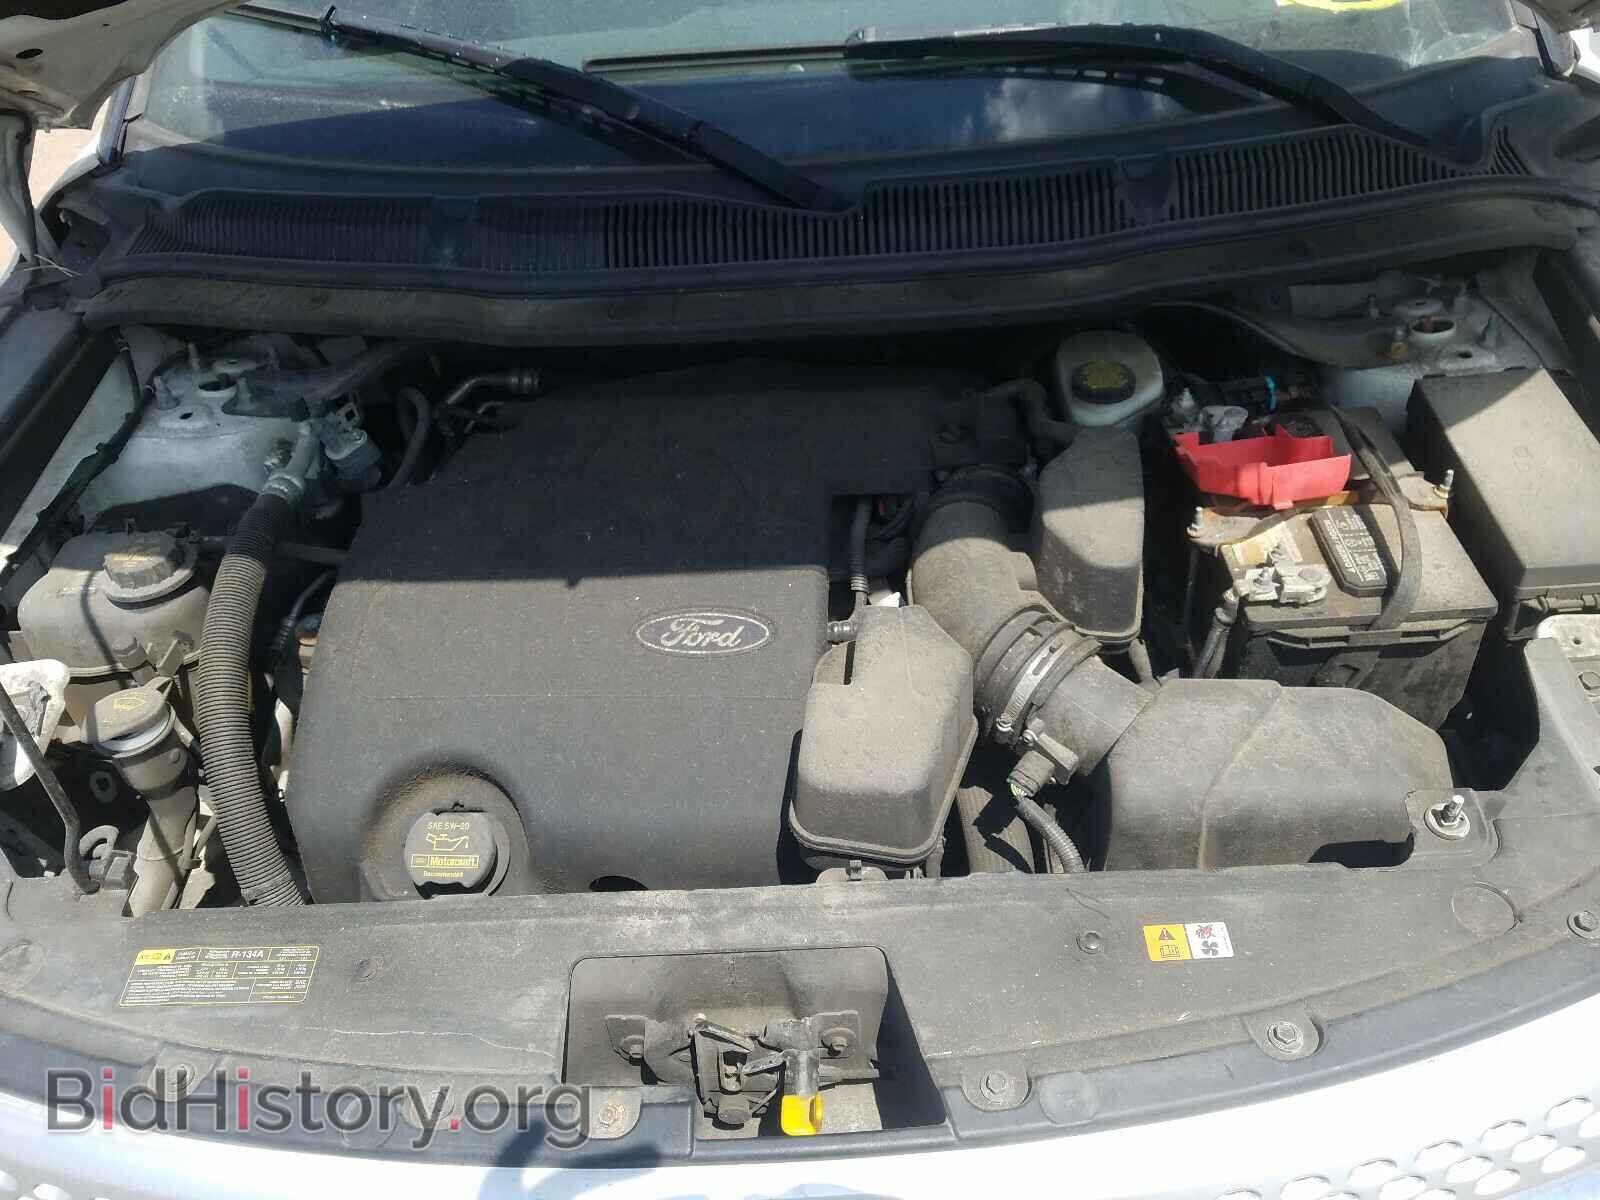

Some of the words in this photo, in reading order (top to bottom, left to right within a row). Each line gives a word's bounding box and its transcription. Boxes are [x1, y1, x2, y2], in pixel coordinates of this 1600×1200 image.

[661, 618, 745, 648] Ford
[427, 822, 442, 830] SAE
[444, 822, 470, 830] 5W-20
[430, 856, 476, 867] Motorcraft
[231, 950, 264, 959] R-134A
